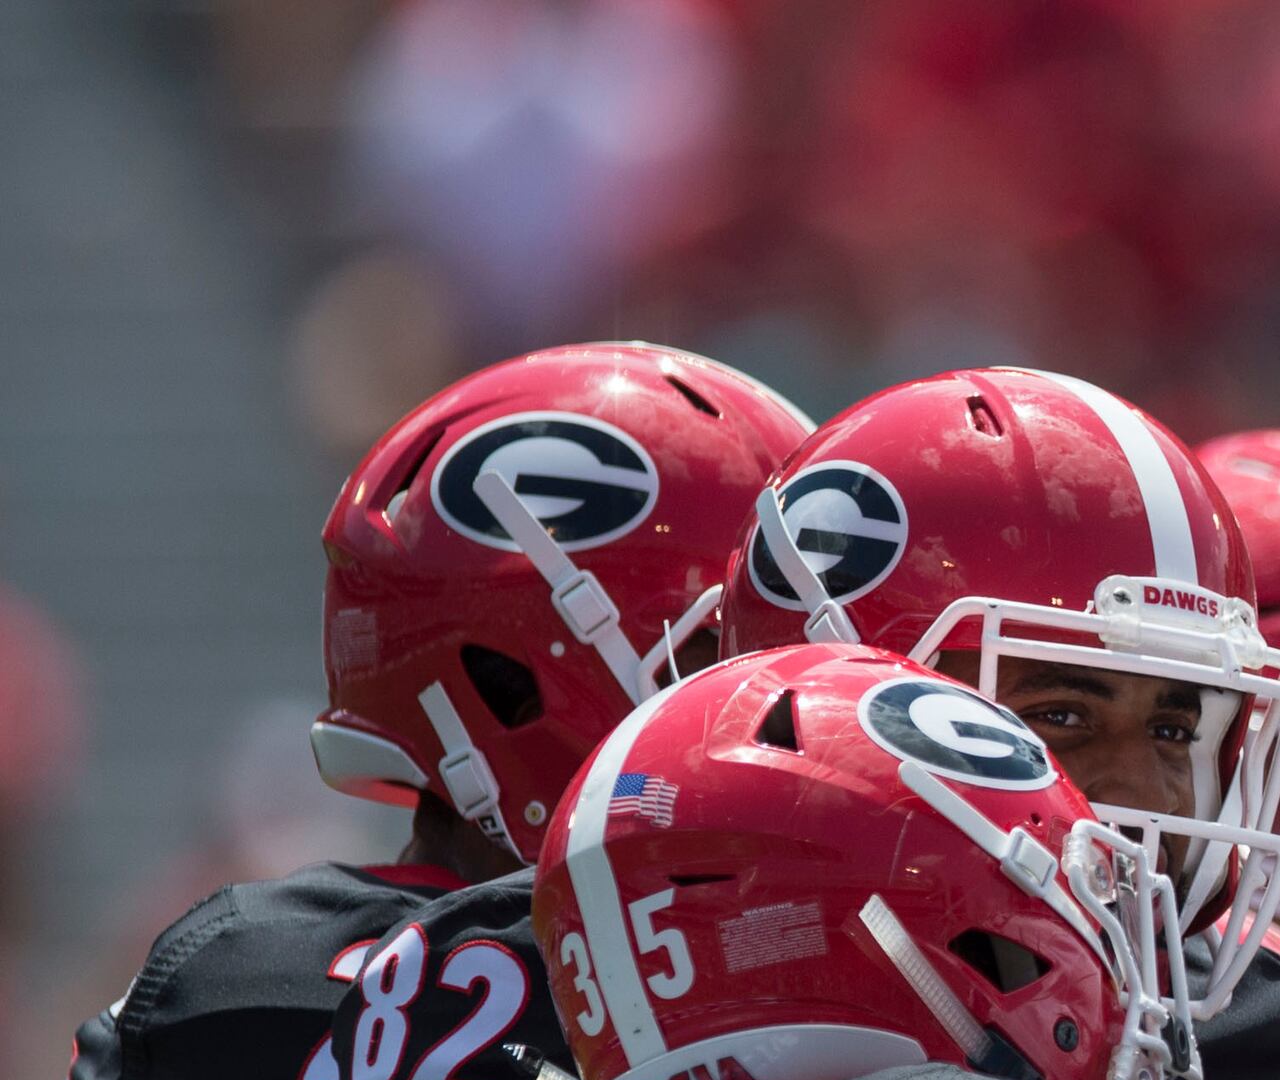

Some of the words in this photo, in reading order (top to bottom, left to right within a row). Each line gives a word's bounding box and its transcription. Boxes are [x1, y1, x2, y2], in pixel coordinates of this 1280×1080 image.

[434, 416, 655, 547] G
[1143, 584, 1219, 618] DAWGS
[862, 680, 1053, 786] G
